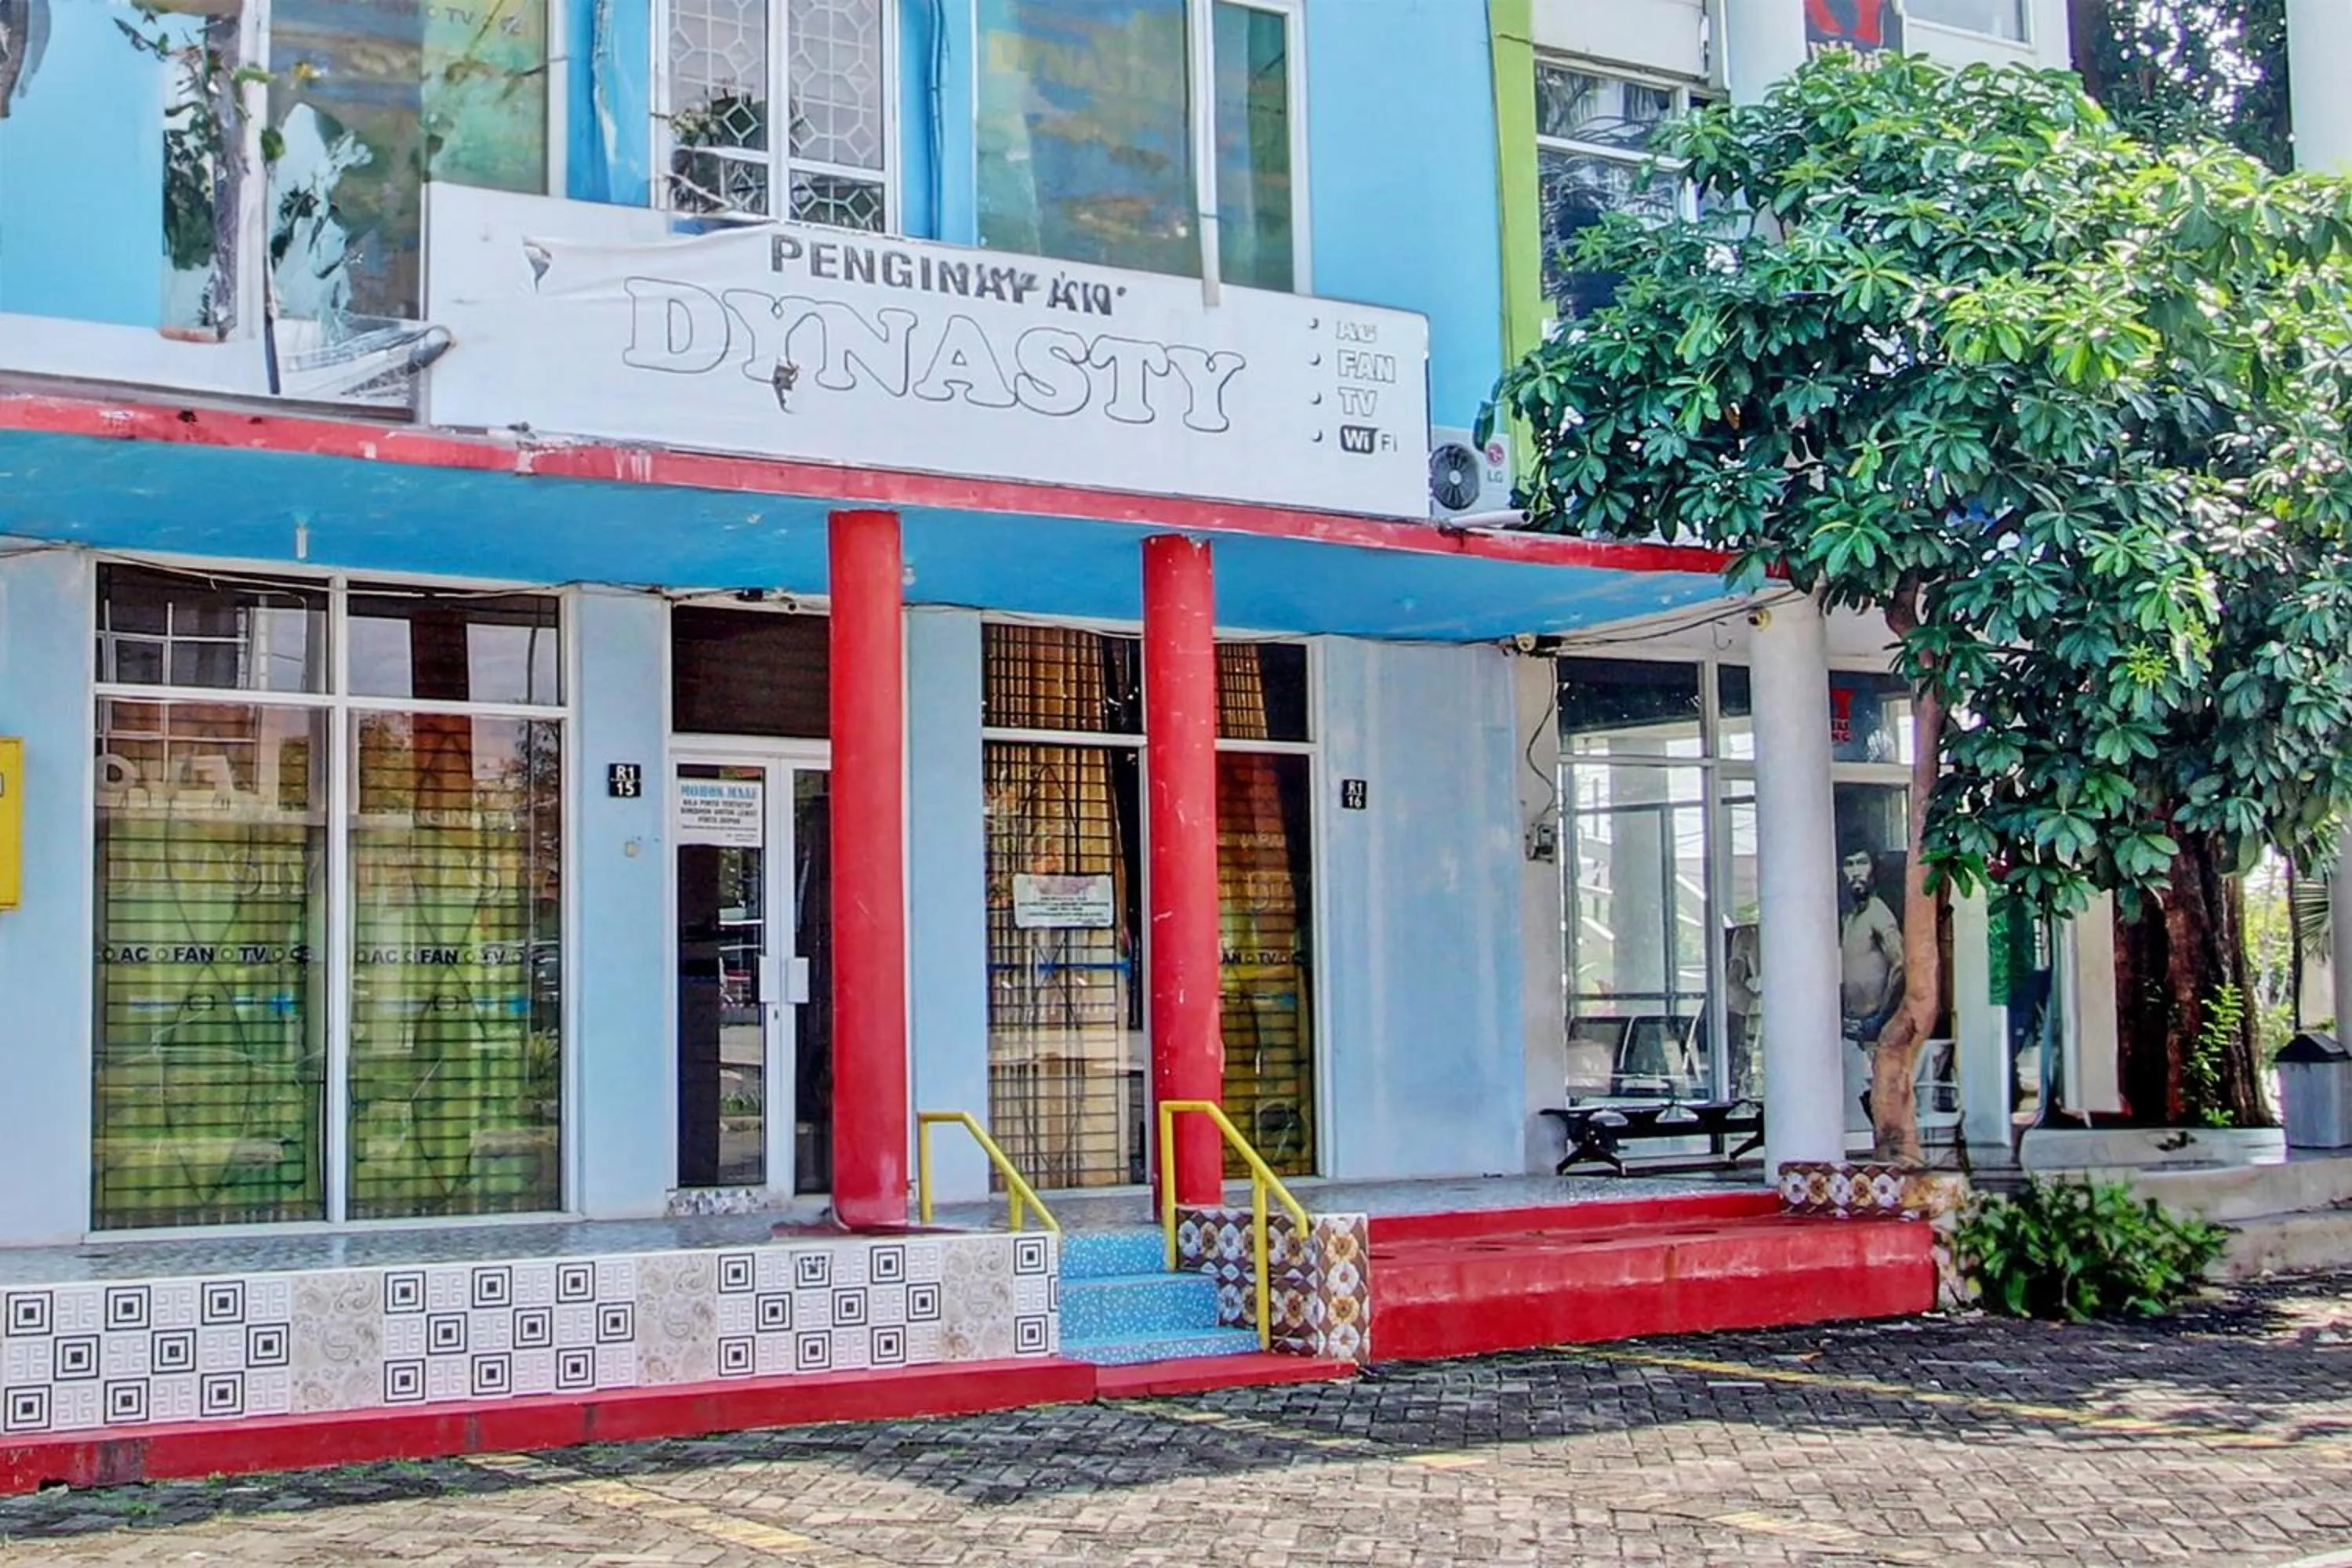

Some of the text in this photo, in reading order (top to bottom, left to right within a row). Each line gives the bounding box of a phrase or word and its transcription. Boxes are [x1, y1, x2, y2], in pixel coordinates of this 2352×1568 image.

[1335, 318, 1377, 343] AC
[622, 276, 1247, 433] DYNASTY
[1338, 350, 1396, 383] FAN
[1338, 387, 1377, 417] TV
[1486, 471, 1503, 483] LG
[617, 781, 634, 796] 15
[1348, 796, 1362, 808] 16
[121, 947, 268, 962] AC FAN TV
[372, 949, 399, 964] AC
[421, 949, 459, 964] FAN
[1221, 949, 1242, 965] AN
